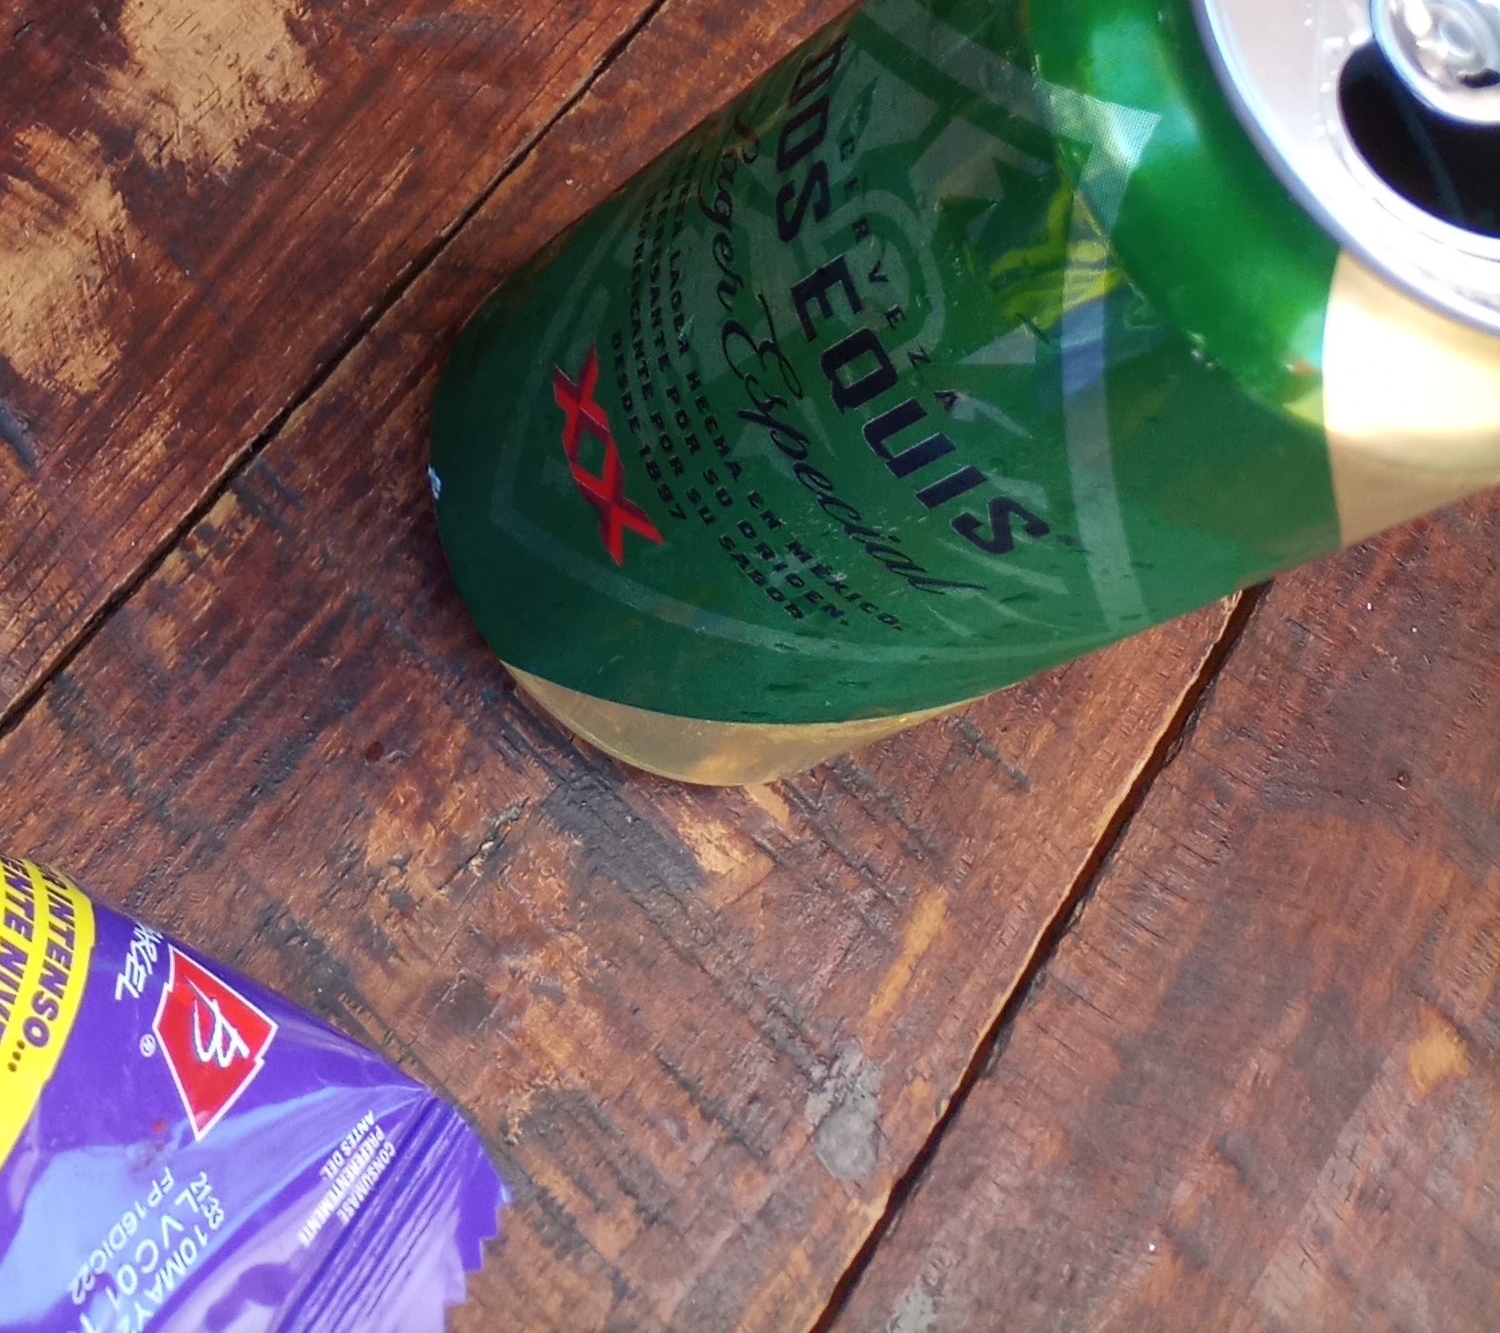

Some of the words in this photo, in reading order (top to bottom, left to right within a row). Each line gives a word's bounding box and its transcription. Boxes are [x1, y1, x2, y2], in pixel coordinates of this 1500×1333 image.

[838, 137, 962, 412] CERVEZA
[553, 342, 666, 569] XX
[639, 443, 688, 522] 1897
[649, 409, 685, 478] POR
[685, 486, 717, 528] SU
[665, 385, 700, 456] POR
[701, 467, 735, 509] SU
[721, 292, 988, 595] Especial
[790, 256, 1052, 556] EQUIS
